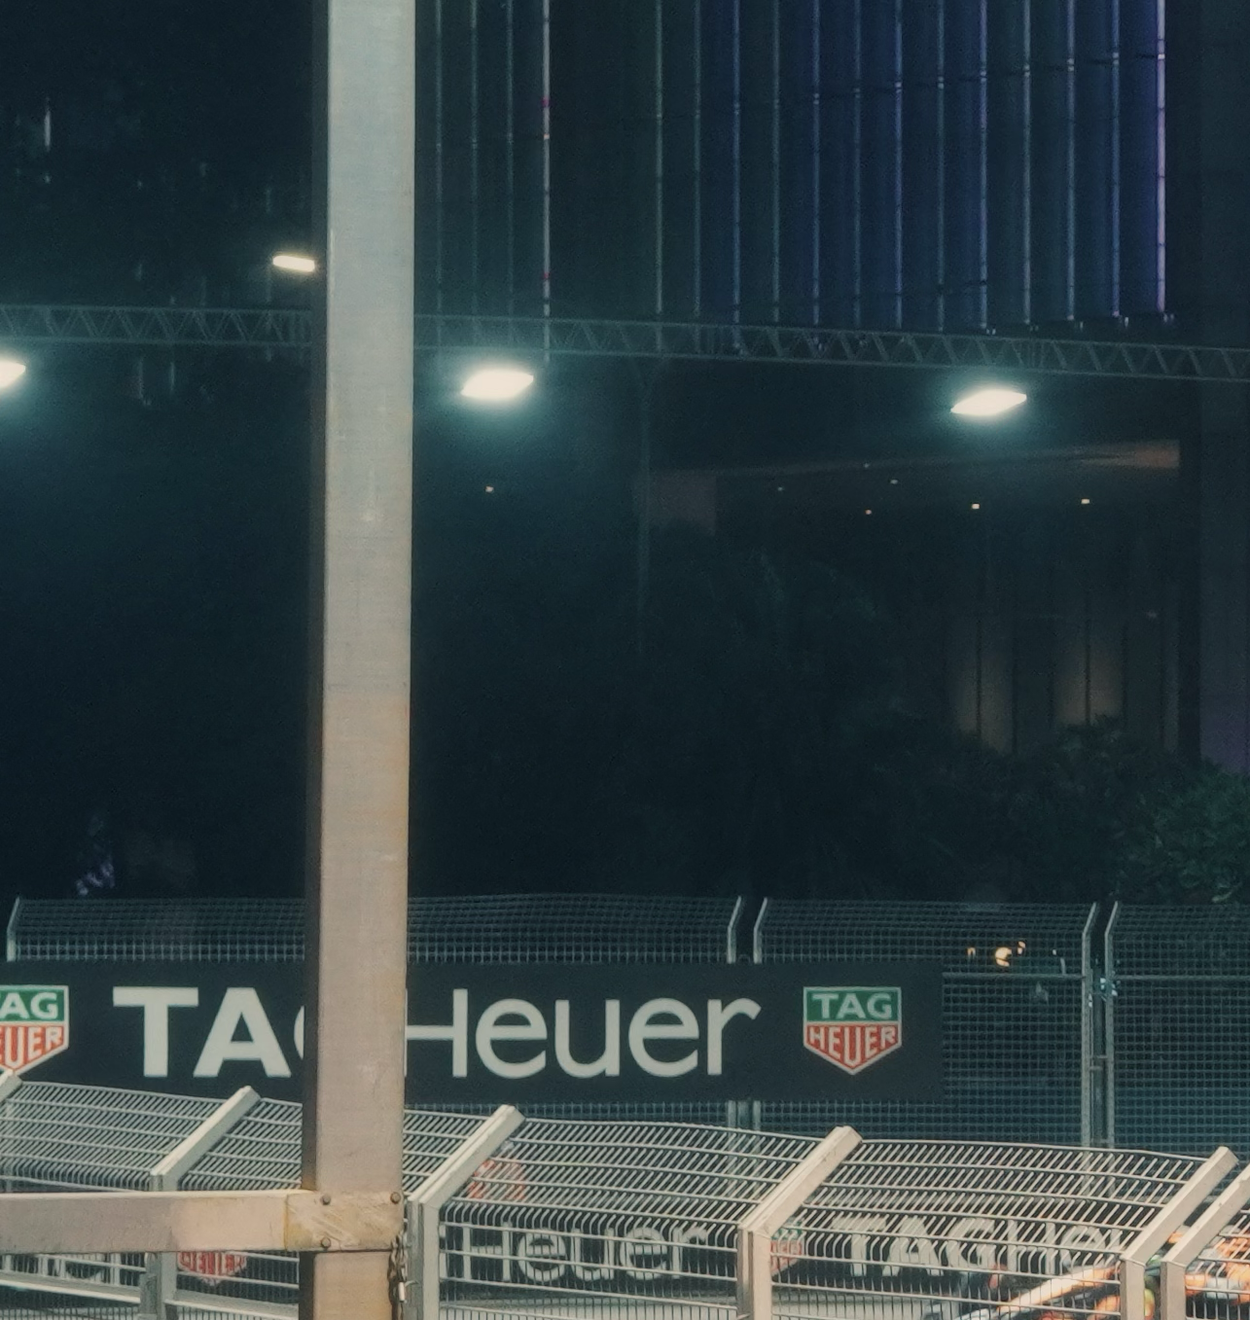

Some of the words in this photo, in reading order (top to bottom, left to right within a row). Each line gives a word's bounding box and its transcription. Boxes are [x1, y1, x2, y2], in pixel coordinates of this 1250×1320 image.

[0, 992, 59, 1020] AG
[811, 992, 893, 1020] TAG
[112, 986, 305, 1078] TA
[808, 1026, 897, 1068] HEUER
[462, 1222, 708, 1282] Heuer
